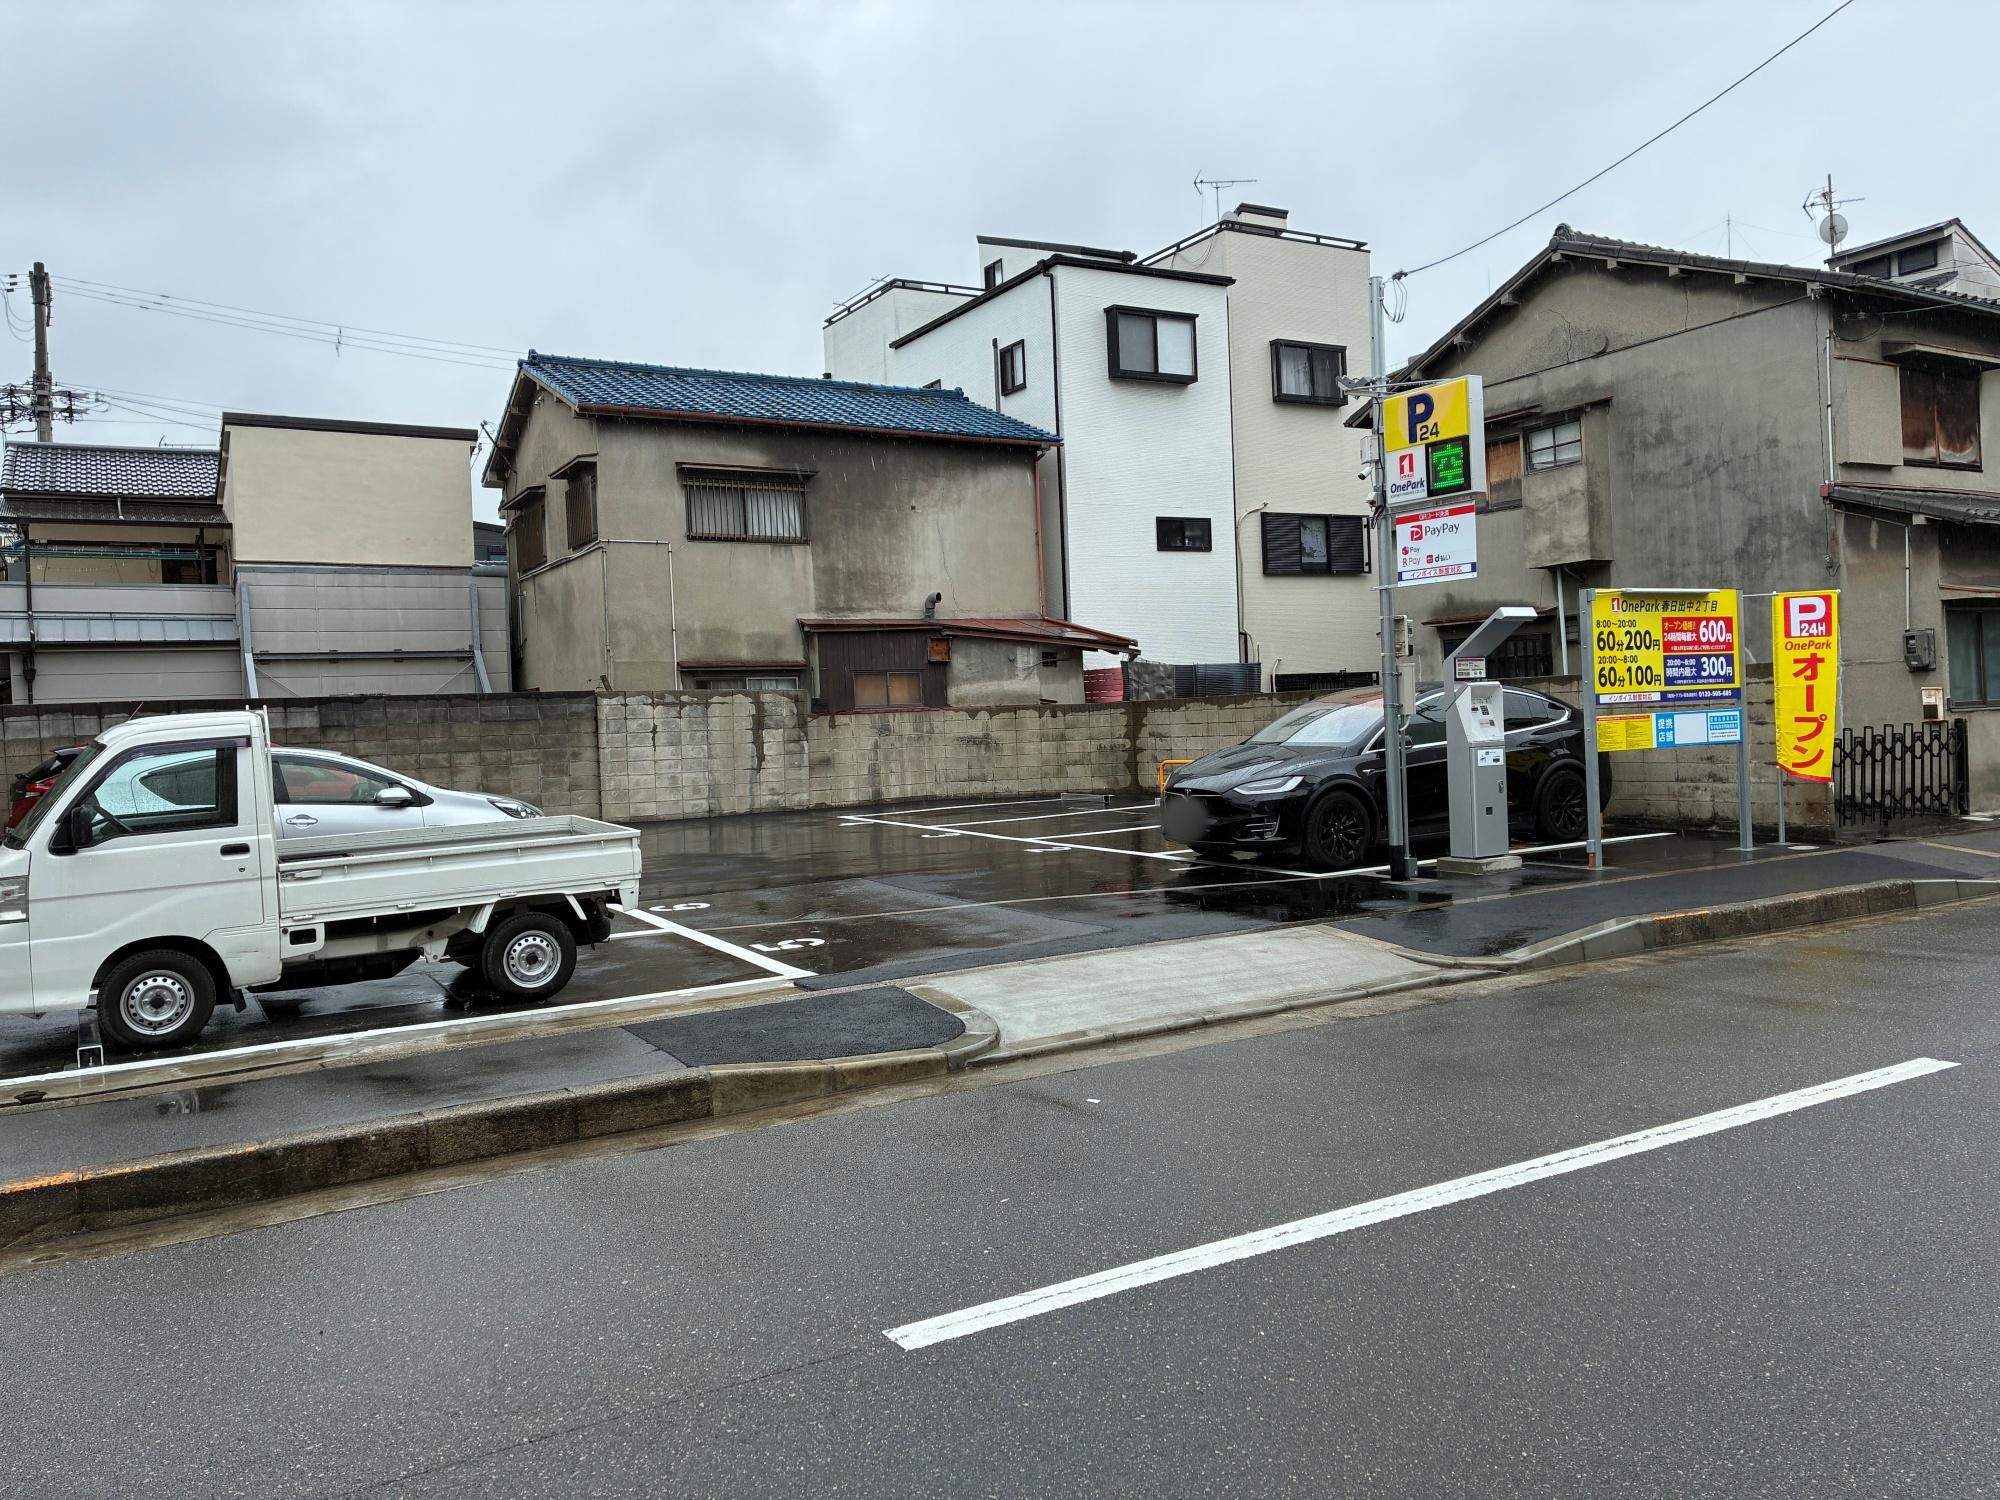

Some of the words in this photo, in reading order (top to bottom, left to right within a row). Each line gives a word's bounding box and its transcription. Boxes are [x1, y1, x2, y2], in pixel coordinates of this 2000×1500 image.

[1407, 393, 1435, 443] P
[1419, 421, 1440, 441] 24
[1391, 478, 1425, 494] OnePark
[1424, 523, 1460, 537] PayPay
[1408, 557, 1421, 566] Pay
[1435, 554, 1451, 562] d払い
[1621, 599, 1660, 613] OnePark
[1789, 596, 1826, 637] P
[1699, 620, 1733, 643] 600円
[1800, 622, 1826, 636] 24H
[1784, 639, 1832, 651] OnePark
[1666, 667, 1697, 677] 時間内最大
[1700, 656, 1733, 677] 300円
[1791, 653, 1828, 768] オープン
[1658, 731, 1673, 742] 店舗
